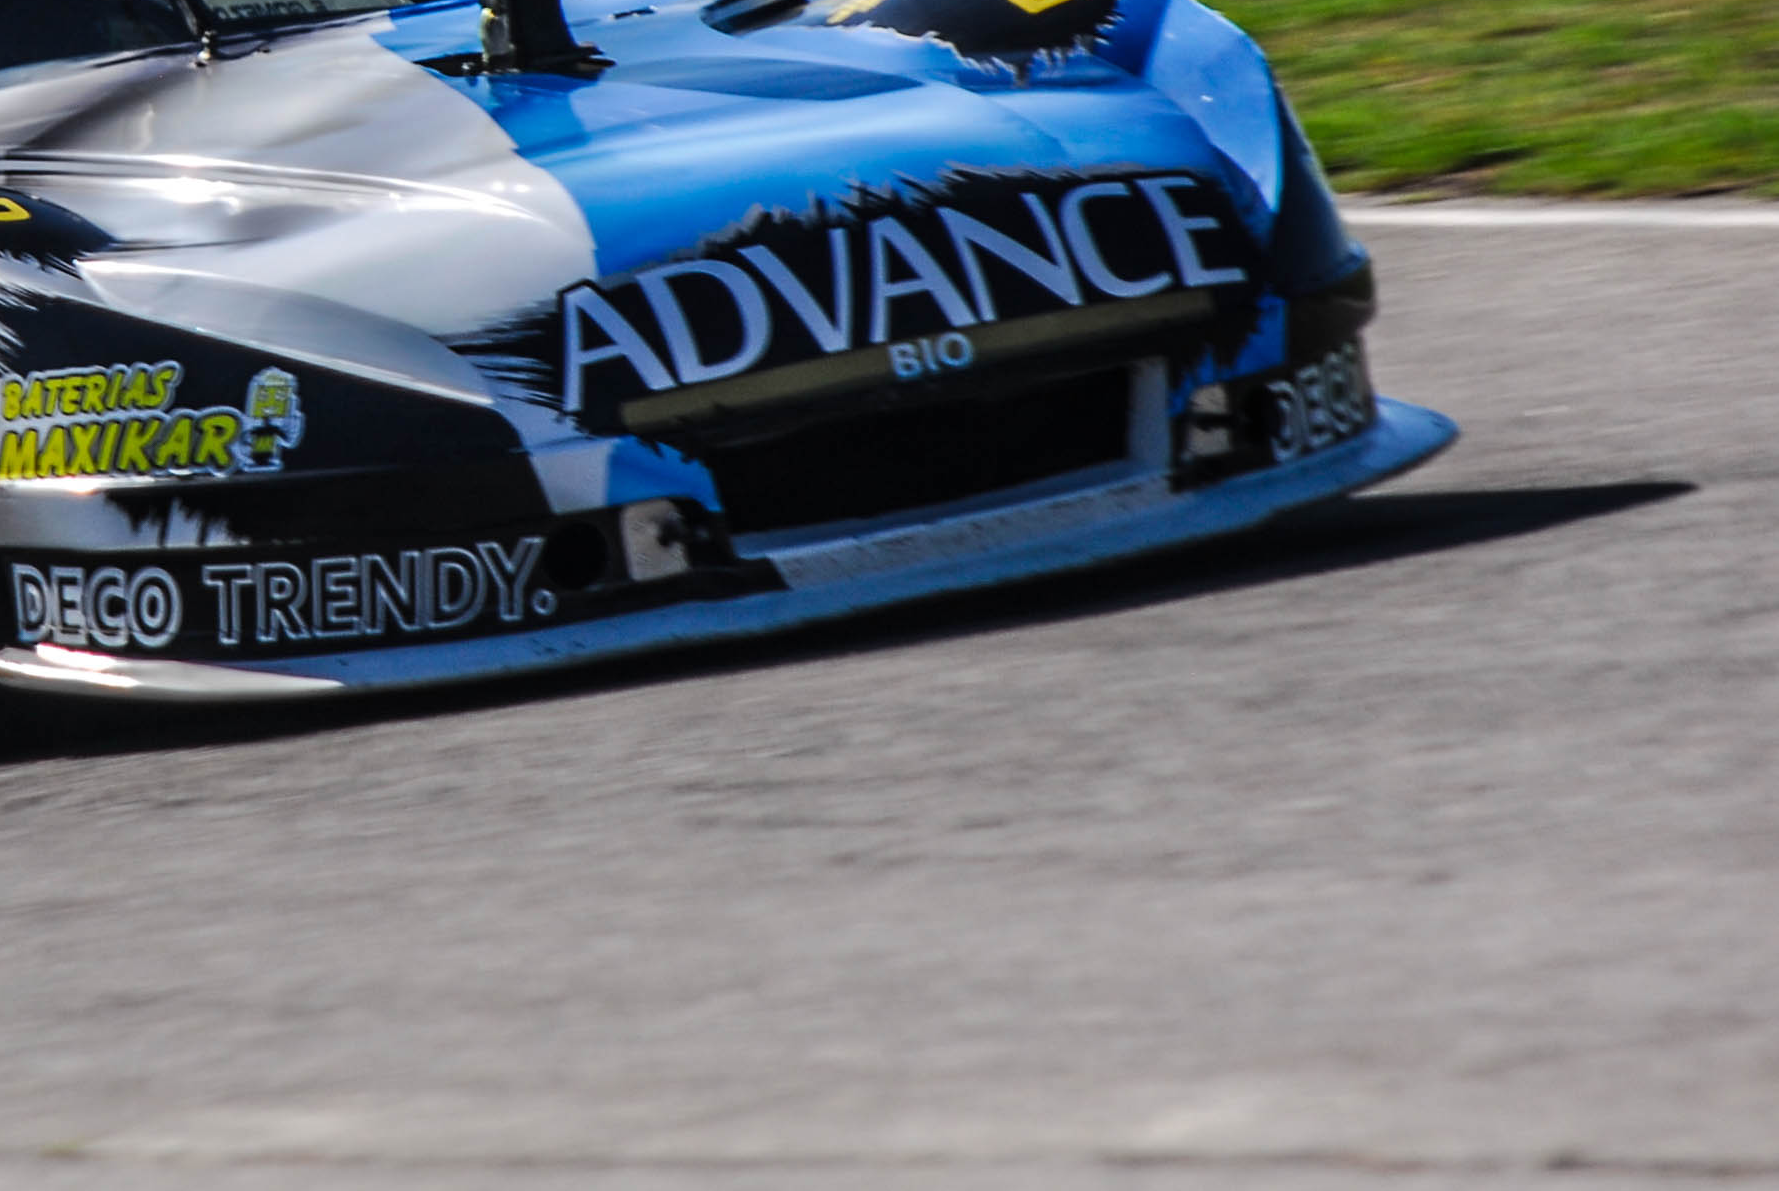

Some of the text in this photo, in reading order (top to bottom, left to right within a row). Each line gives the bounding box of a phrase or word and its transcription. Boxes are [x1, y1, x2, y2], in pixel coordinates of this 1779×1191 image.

[564, 176, 1247, 411] ADVANCE
[888, 332, 974, 378] BIO
[2, 367, 174, 420] BATERIAS
[11, 561, 183, 648] DECO
